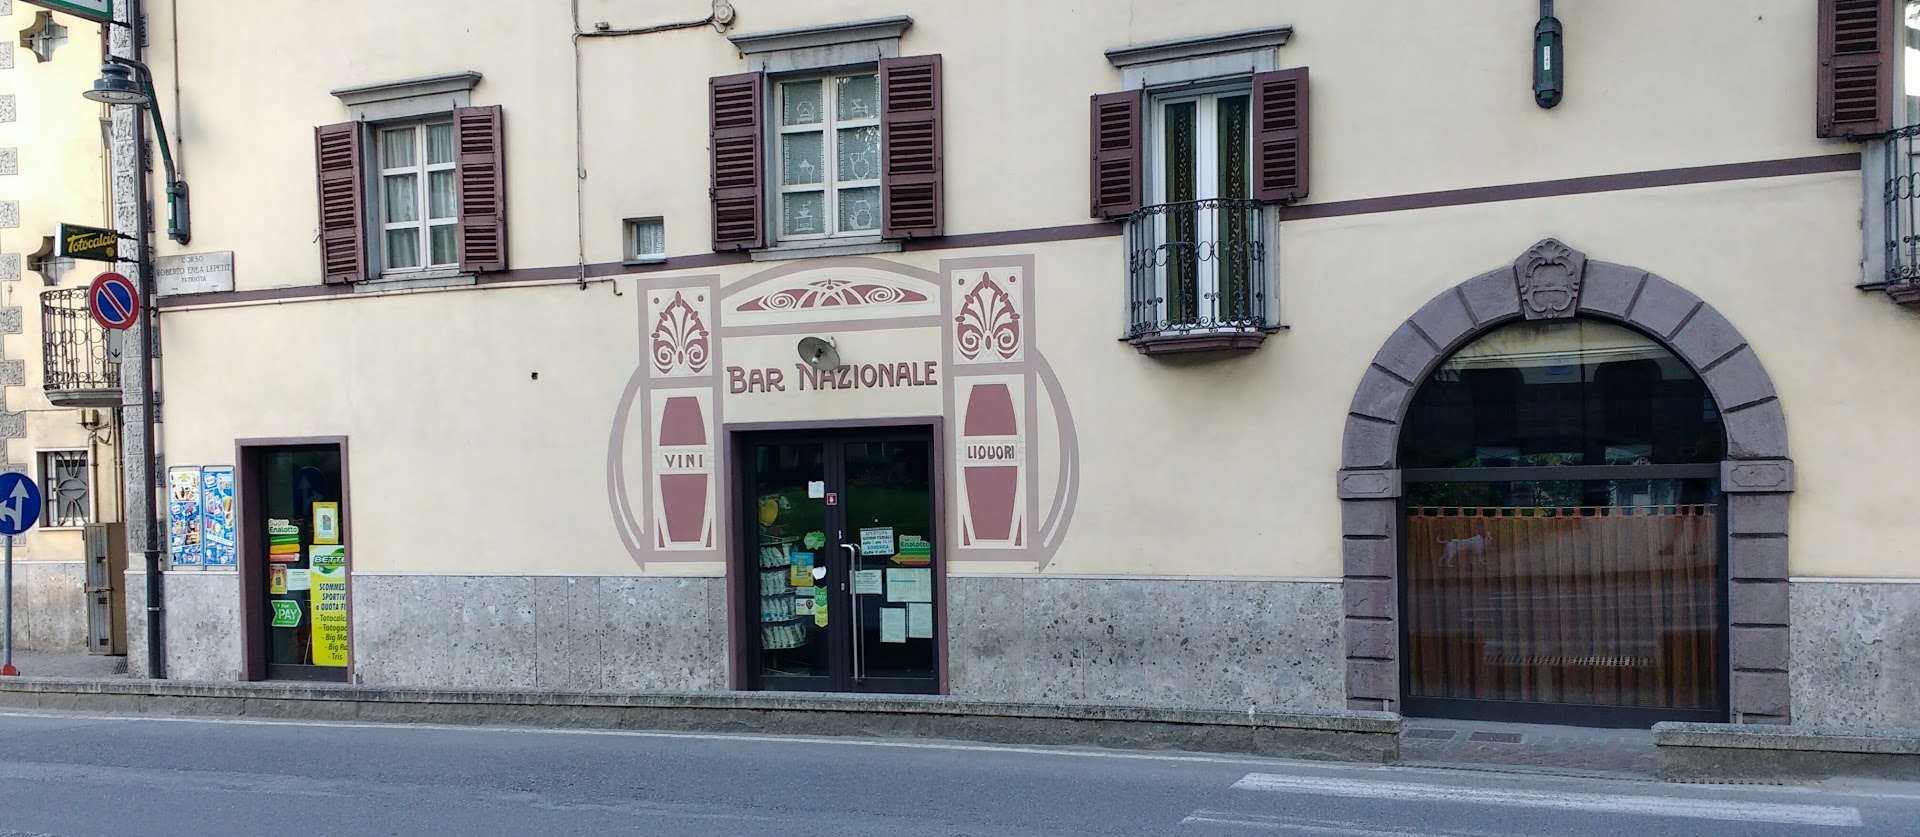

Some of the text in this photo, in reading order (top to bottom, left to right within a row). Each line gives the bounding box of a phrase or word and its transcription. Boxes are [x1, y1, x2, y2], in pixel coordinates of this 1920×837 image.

[66, 232, 117, 254] Totocalcio
[181, 255, 204, 264] CORSO
[156, 263, 231, 277] ROBERTO ENEA LEPETIT
[181, 275, 207, 284] PATRIOTA
[727, 361, 938, 394] BAR NAZIONALE
[967, 445, 1015, 460] LIQUORI
[664, 454, 703, 468] VINI
[269, 519, 289, 527] Super
[319, 583, 345, 591] SCOMMES
[322, 593, 346, 601] SPORTIV
[321, 603, 339, 611] QUOTA
[278, 608, 297, 620] PAY
[320, 614, 347, 622] Totocalc
[326, 634, 336, 643] Big
[329, 643, 339, 652] Big
[332, 652, 343, 660] Tris
